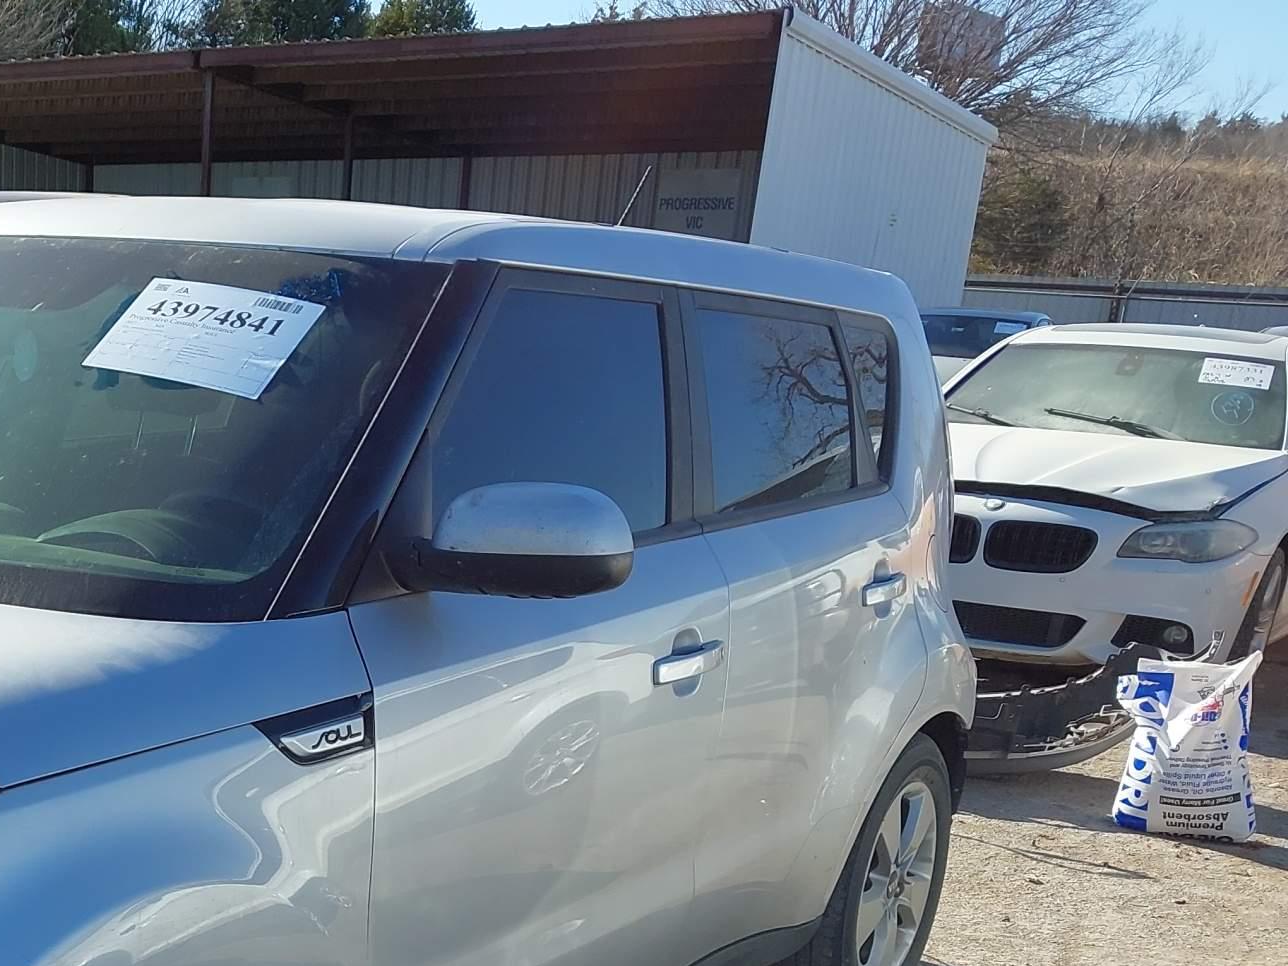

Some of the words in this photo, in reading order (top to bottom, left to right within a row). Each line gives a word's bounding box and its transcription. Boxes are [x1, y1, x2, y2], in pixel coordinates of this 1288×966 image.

[659, 197, 736, 210] PROGRESSIVE
[685, 216, 704, 229] VIC
[146, 299, 285, 336] 43974841
[311, 724, 362, 749] SOUL
[1162, 811, 1229, 821] Absorbent
[1166, 821, 1223, 831] Premium
